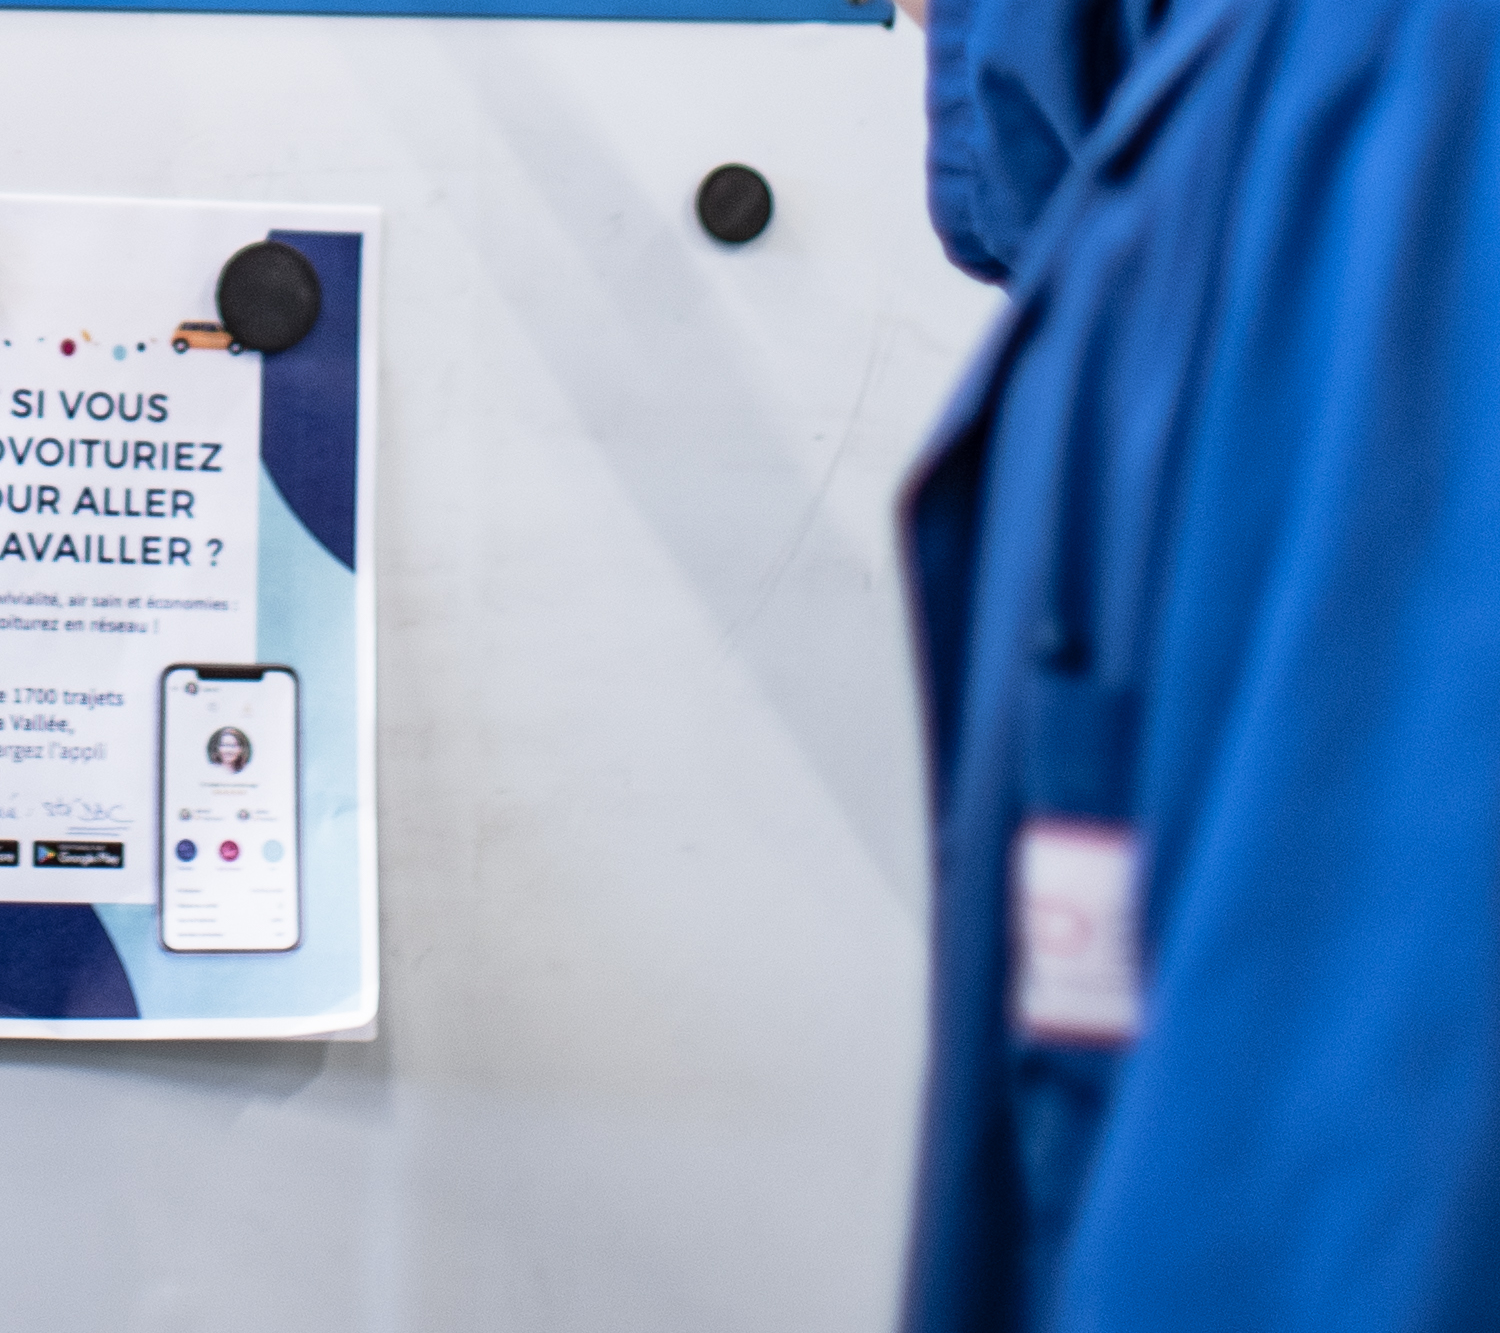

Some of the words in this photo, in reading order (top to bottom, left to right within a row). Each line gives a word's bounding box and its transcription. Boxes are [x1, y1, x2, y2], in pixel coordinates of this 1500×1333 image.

[11, 389, 45, 419] SI
[59, 391, 169, 424] VOUS
[71, 487, 196, 519] ALLER
[207, 537, 224, 567] ?
[65, 619, 84, 631] en
[90, 617, 148, 633] réseau
[13, 688, 57, 704] 1700
[63, 689, 124, 710] trajets
